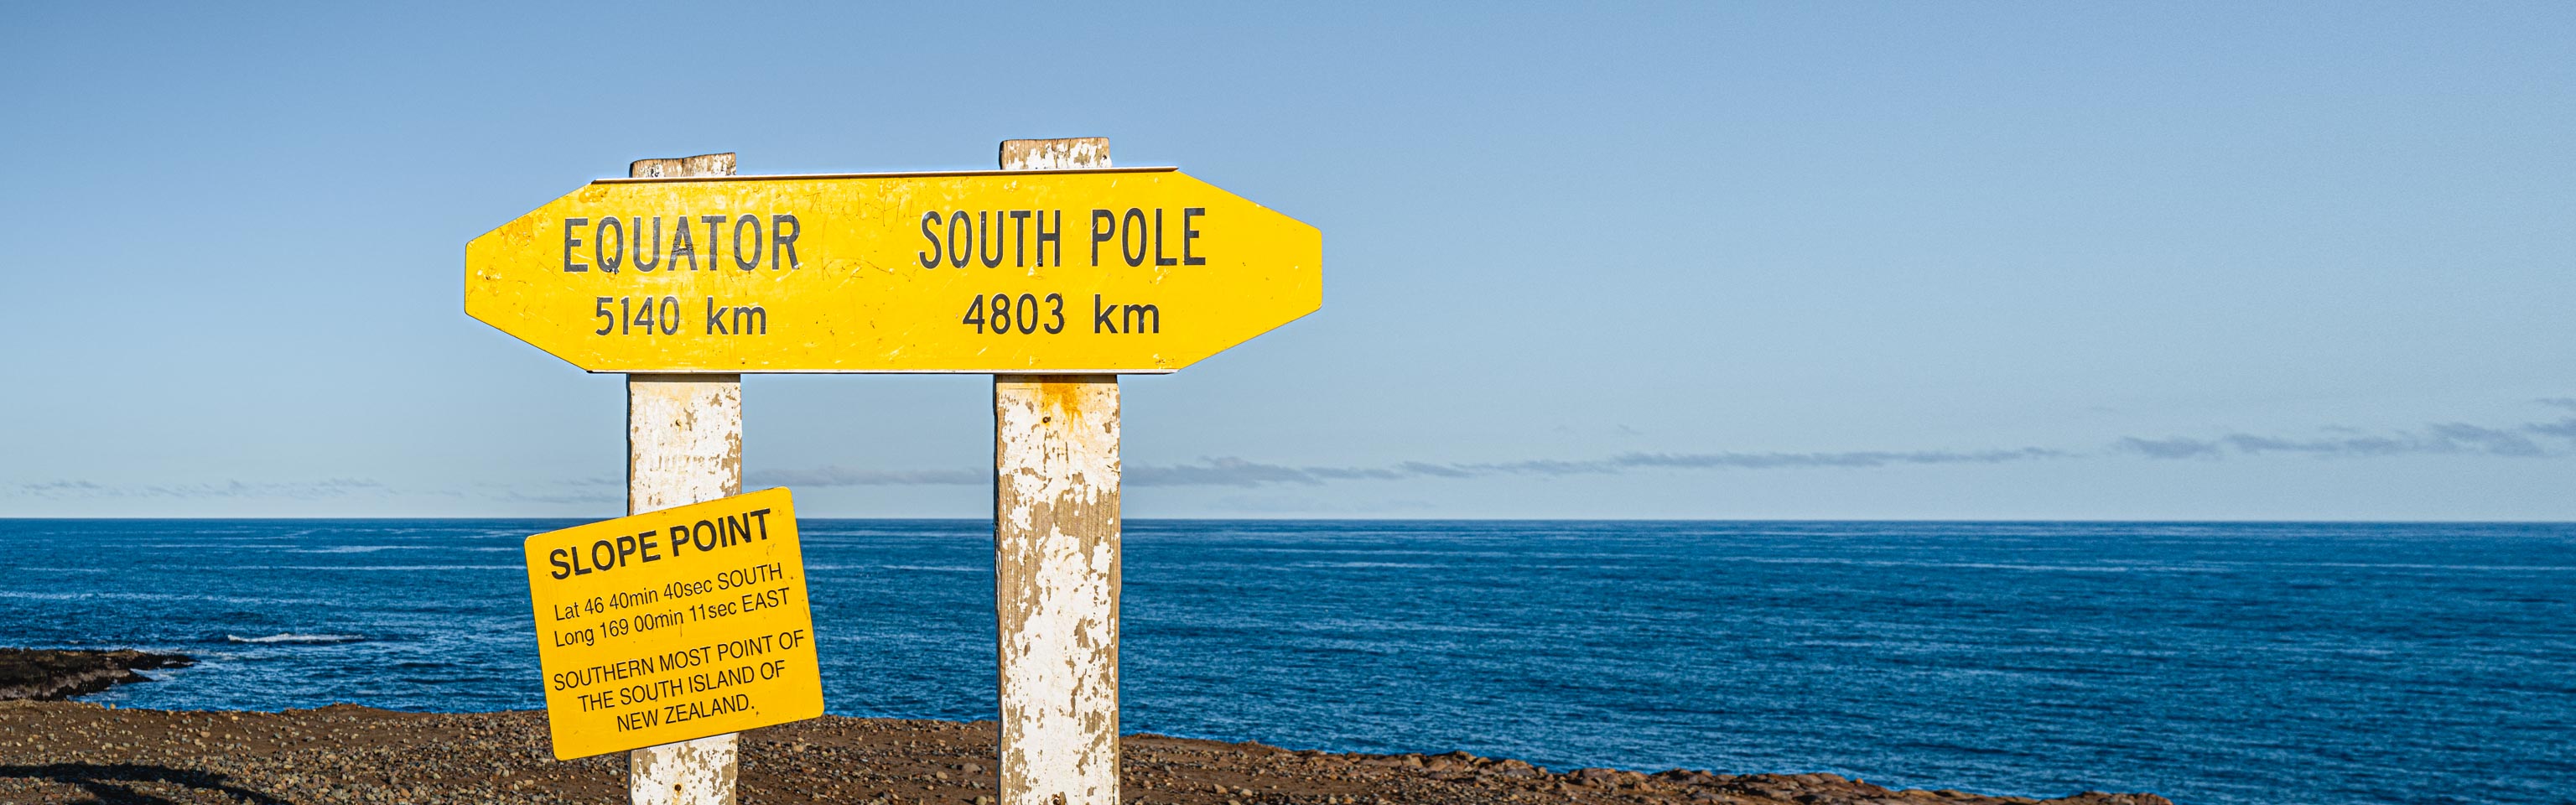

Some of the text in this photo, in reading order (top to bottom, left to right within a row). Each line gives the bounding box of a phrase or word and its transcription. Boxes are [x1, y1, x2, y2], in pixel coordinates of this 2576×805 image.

[564, 214, 801, 274] EQUATOR
[919, 210, 1062, 270] SOUTH
[1091, 207, 1207, 267] POLE
[595, 296, 766, 336] 5140 km
[962, 293, 1160, 335] 4803 km
[549, 508, 771, 579] SLOPE POINT
[554, 563, 782, 621] Lat 46 40min 40sec SOUTH
[554, 587, 790, 647] Long 169 00min 11sec EAST
[553, 630, 804, 691] SOUTHERN MOST POINT OF
[578, 660, 785, 712] THE SOUTH ISLAND OF
[617, 693, 755, 732] NEW ZEALAND.
